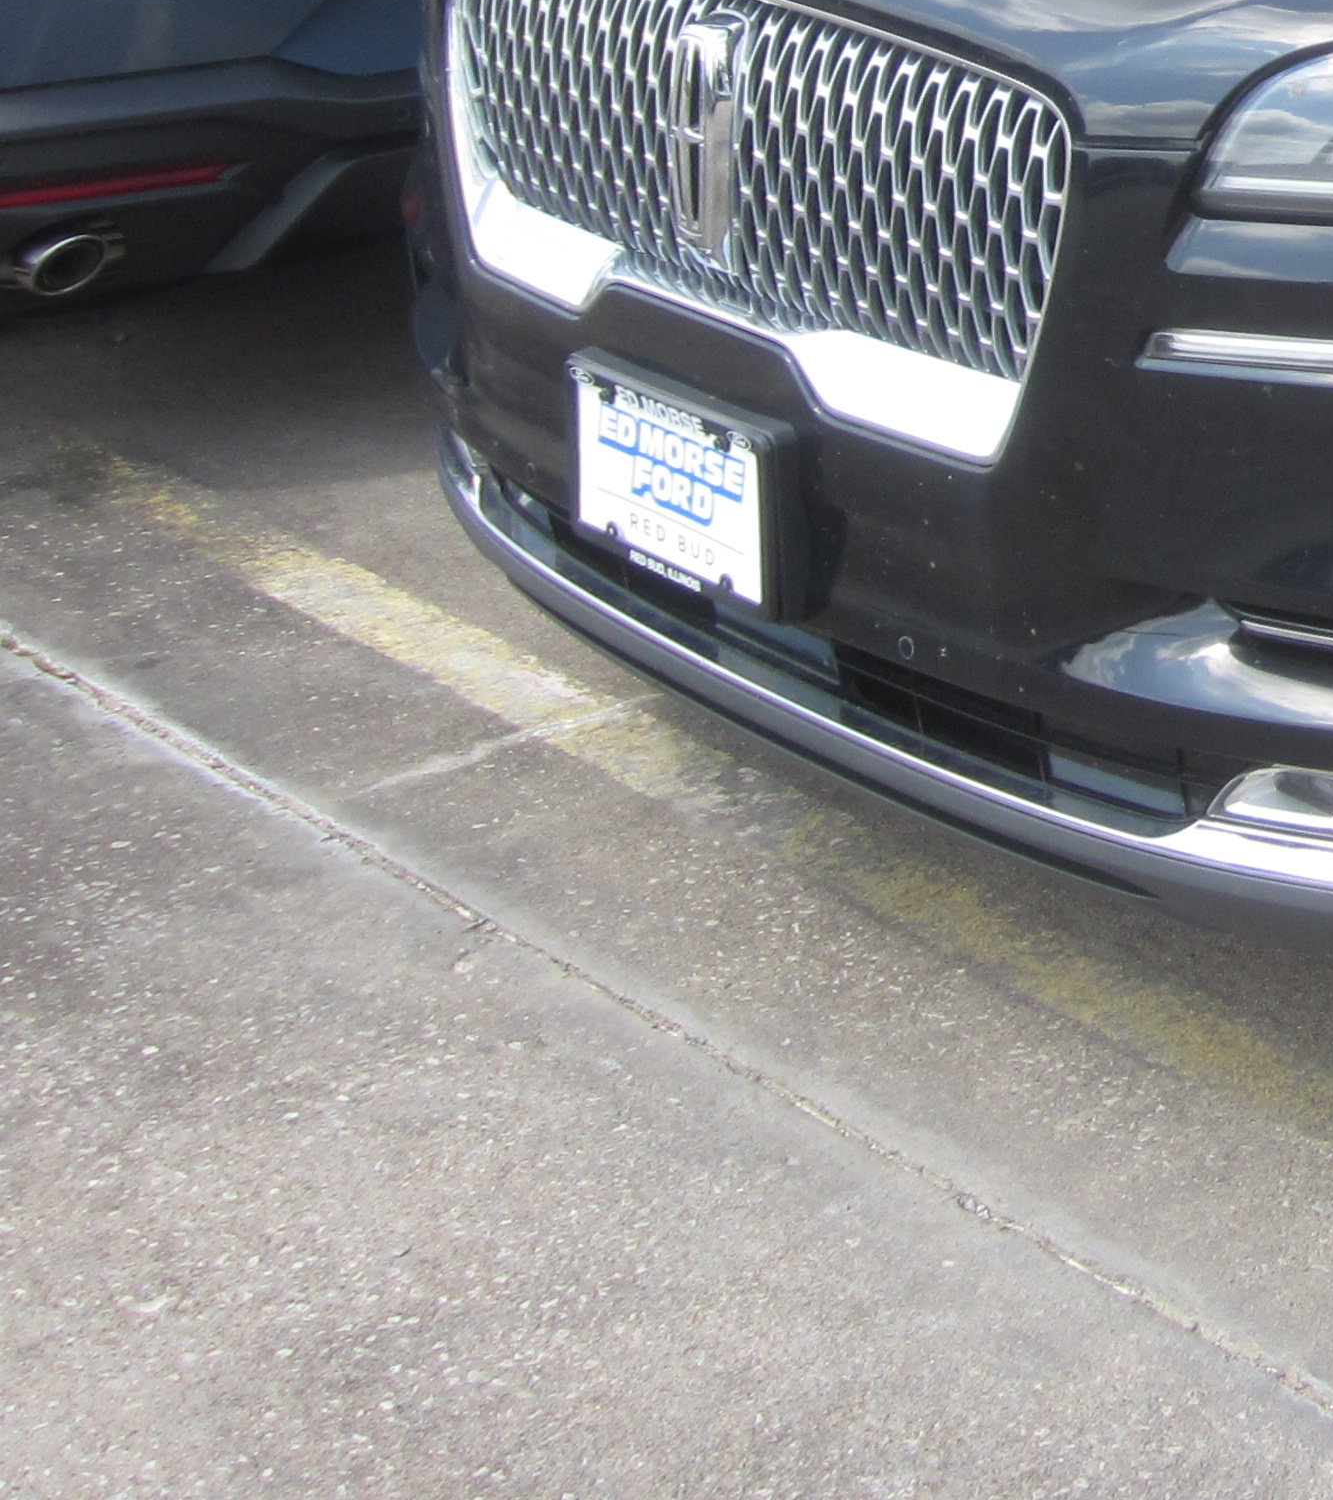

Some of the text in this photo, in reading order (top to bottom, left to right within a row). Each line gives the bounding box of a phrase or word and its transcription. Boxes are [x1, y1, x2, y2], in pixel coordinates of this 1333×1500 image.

[598, 401, 746, 503] ED MORSE
[631, 455, 715, 527] FORD
[629, 512, 717, 567] RED BUD
